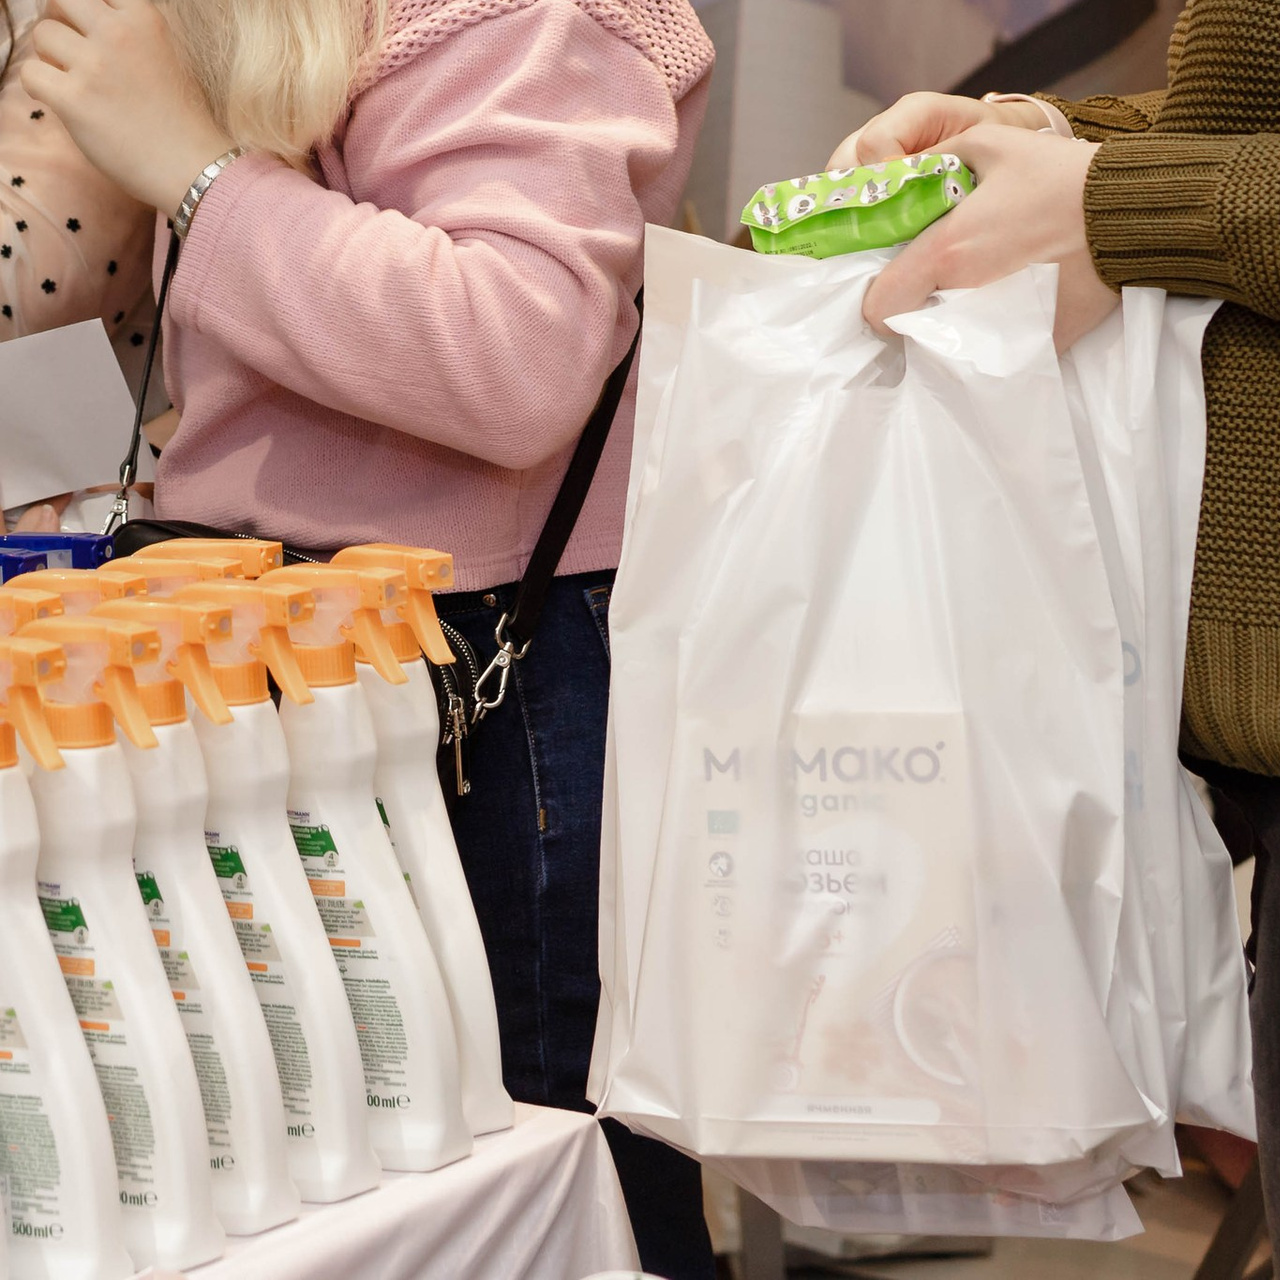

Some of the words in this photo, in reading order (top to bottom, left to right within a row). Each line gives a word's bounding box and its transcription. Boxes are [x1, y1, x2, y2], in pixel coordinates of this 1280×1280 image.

[366, 1094, 380, 1108] 00
[381, 1095, 396, 1108] ml
[128, 1192, 143, 1206] ml
[12, 1221, 33, 1236] 500
[34, 1225, 48, 1238] ml
